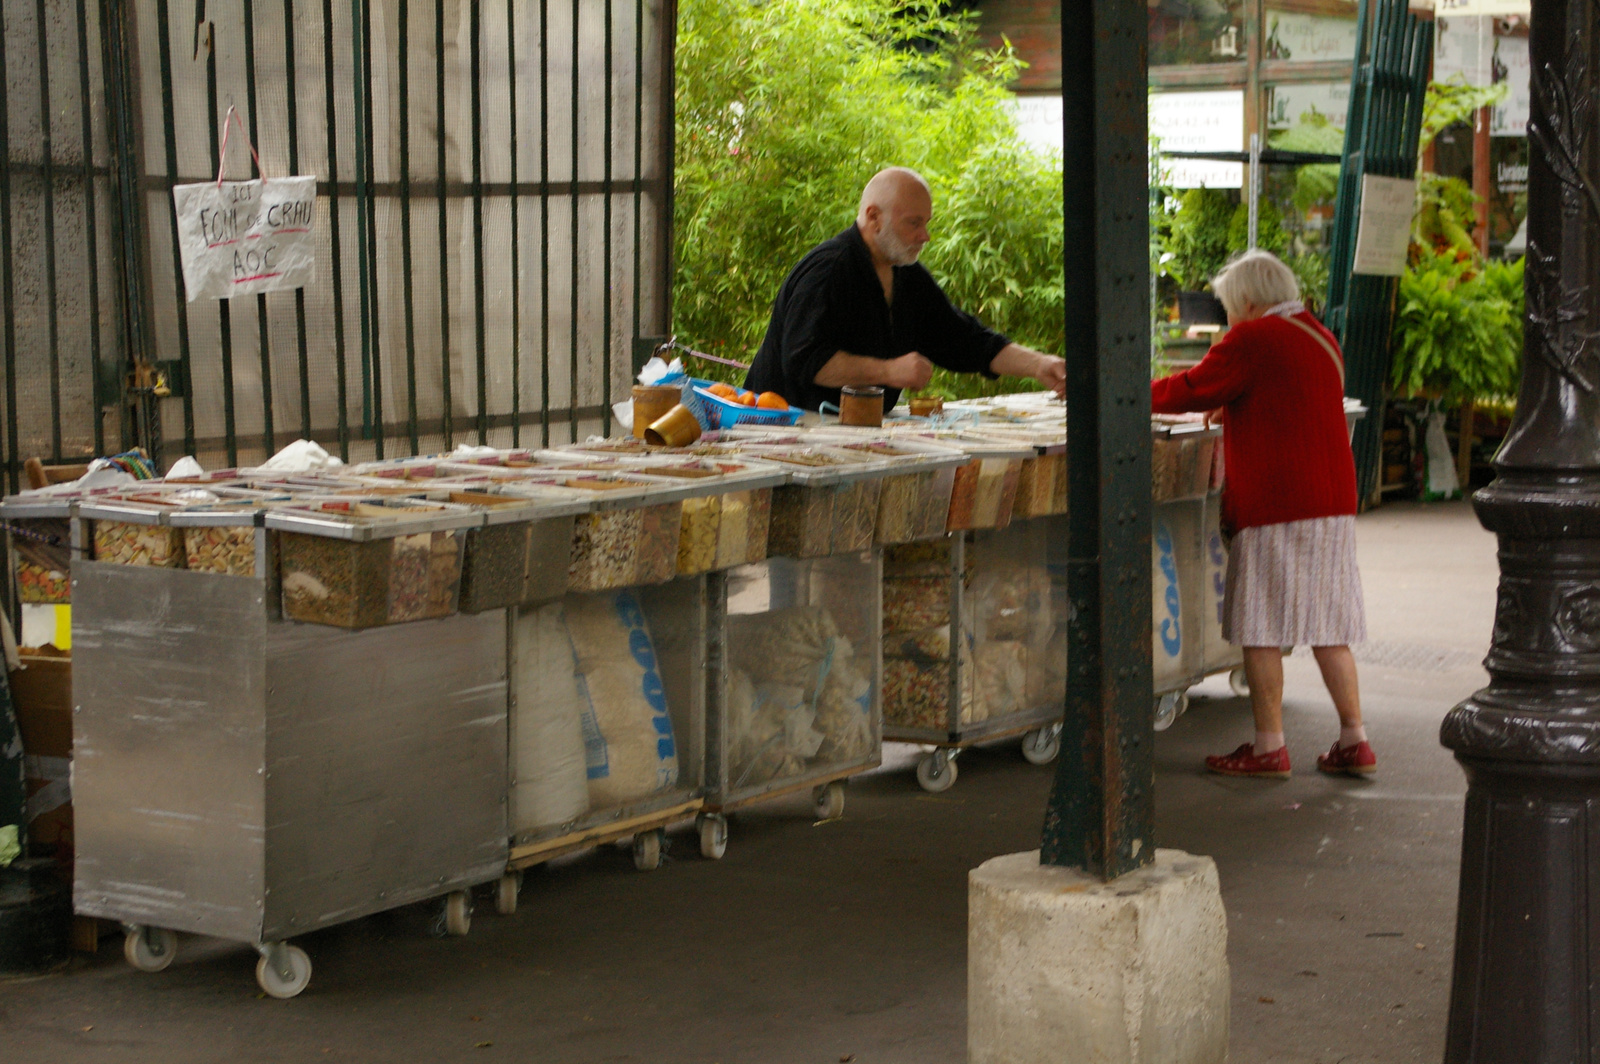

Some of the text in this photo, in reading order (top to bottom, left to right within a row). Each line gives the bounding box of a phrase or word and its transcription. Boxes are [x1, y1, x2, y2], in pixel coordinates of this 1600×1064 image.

[232, 185, 252, 204] ICI
[267, 200, 312, 229] CRAU
[233, 245, 277, 276] AOC
